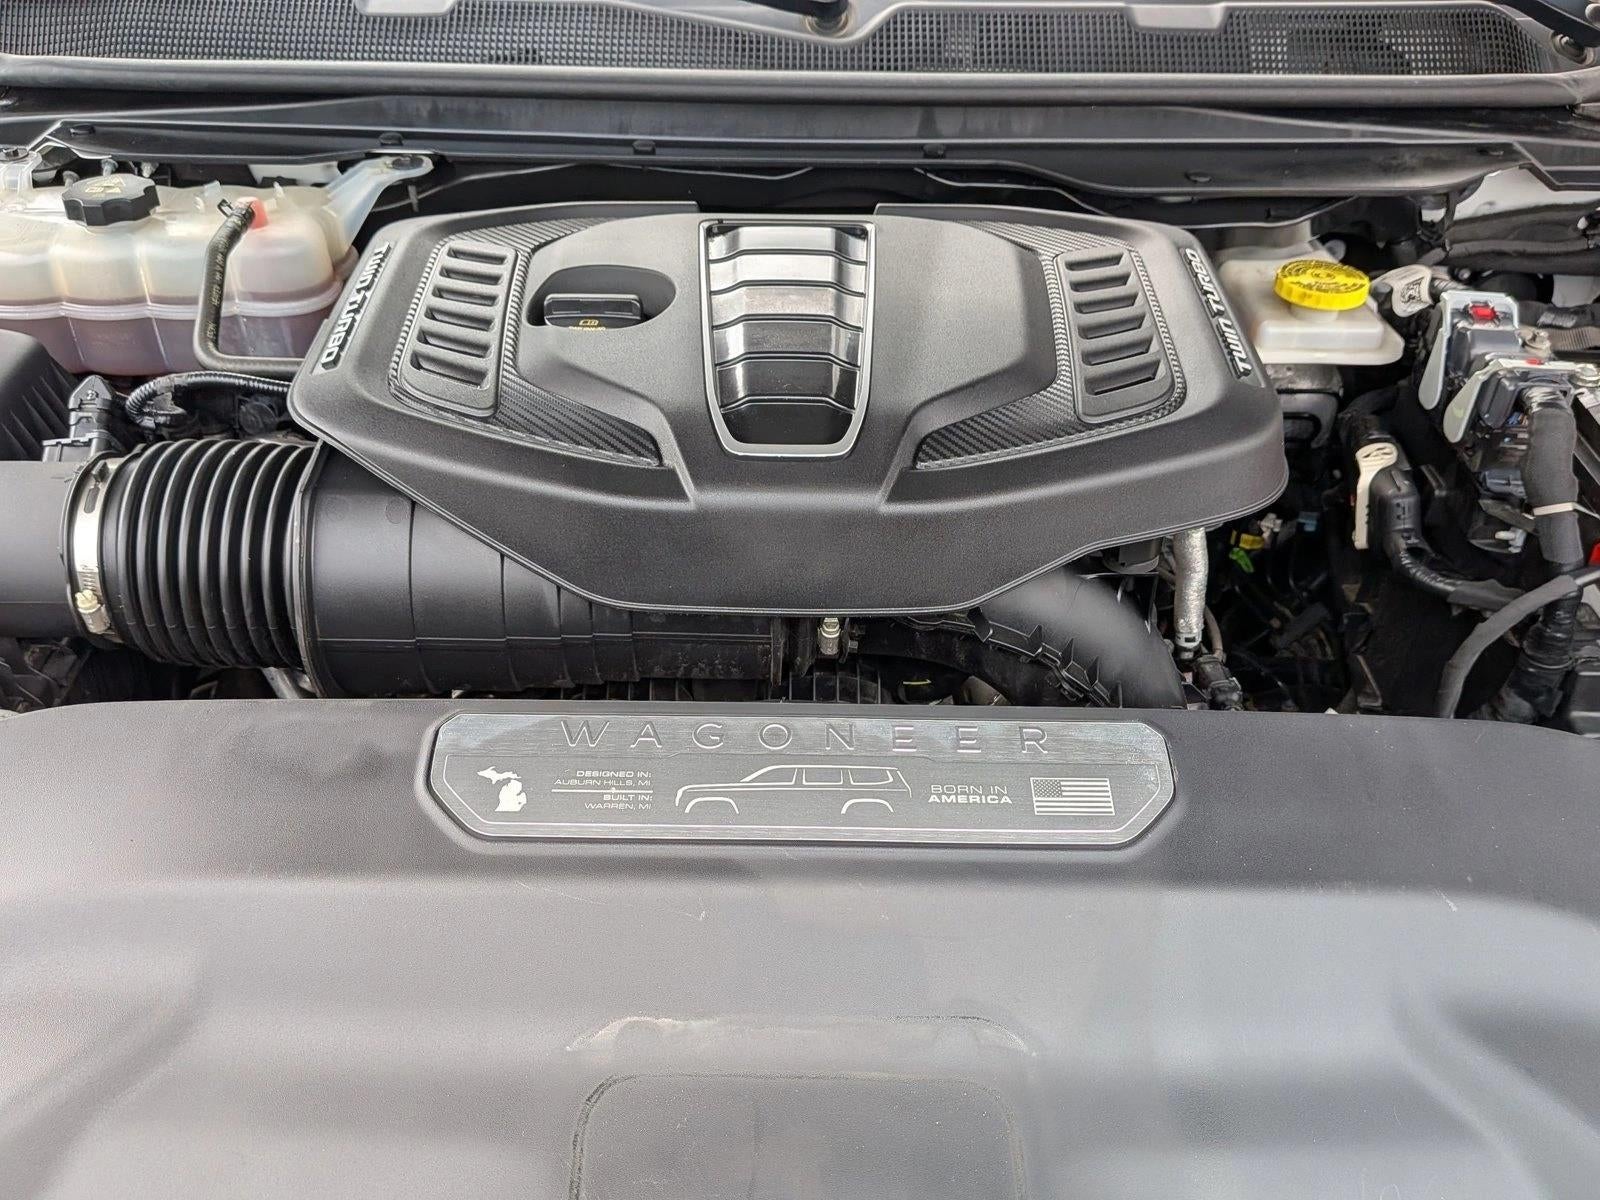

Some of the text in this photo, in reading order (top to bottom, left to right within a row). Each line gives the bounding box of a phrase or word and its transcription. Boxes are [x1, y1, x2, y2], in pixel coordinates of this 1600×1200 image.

[320, 242, 391, 366] TWIN TURBO
[1185, 248, 1251, 373] TWIN TURBO
[561, 720, 1048, 754] WAGONEER
[576, 770, 635, 778] DESIGNED
[554, 778, 601, 786] AUBURN
[603, 779, 635, 787] HILLS,
[930, 784, 1008, 795] BORN IN
[928, 794, 1013, 804] AMERICA
[584, 802, 636, 810] WARREN,
